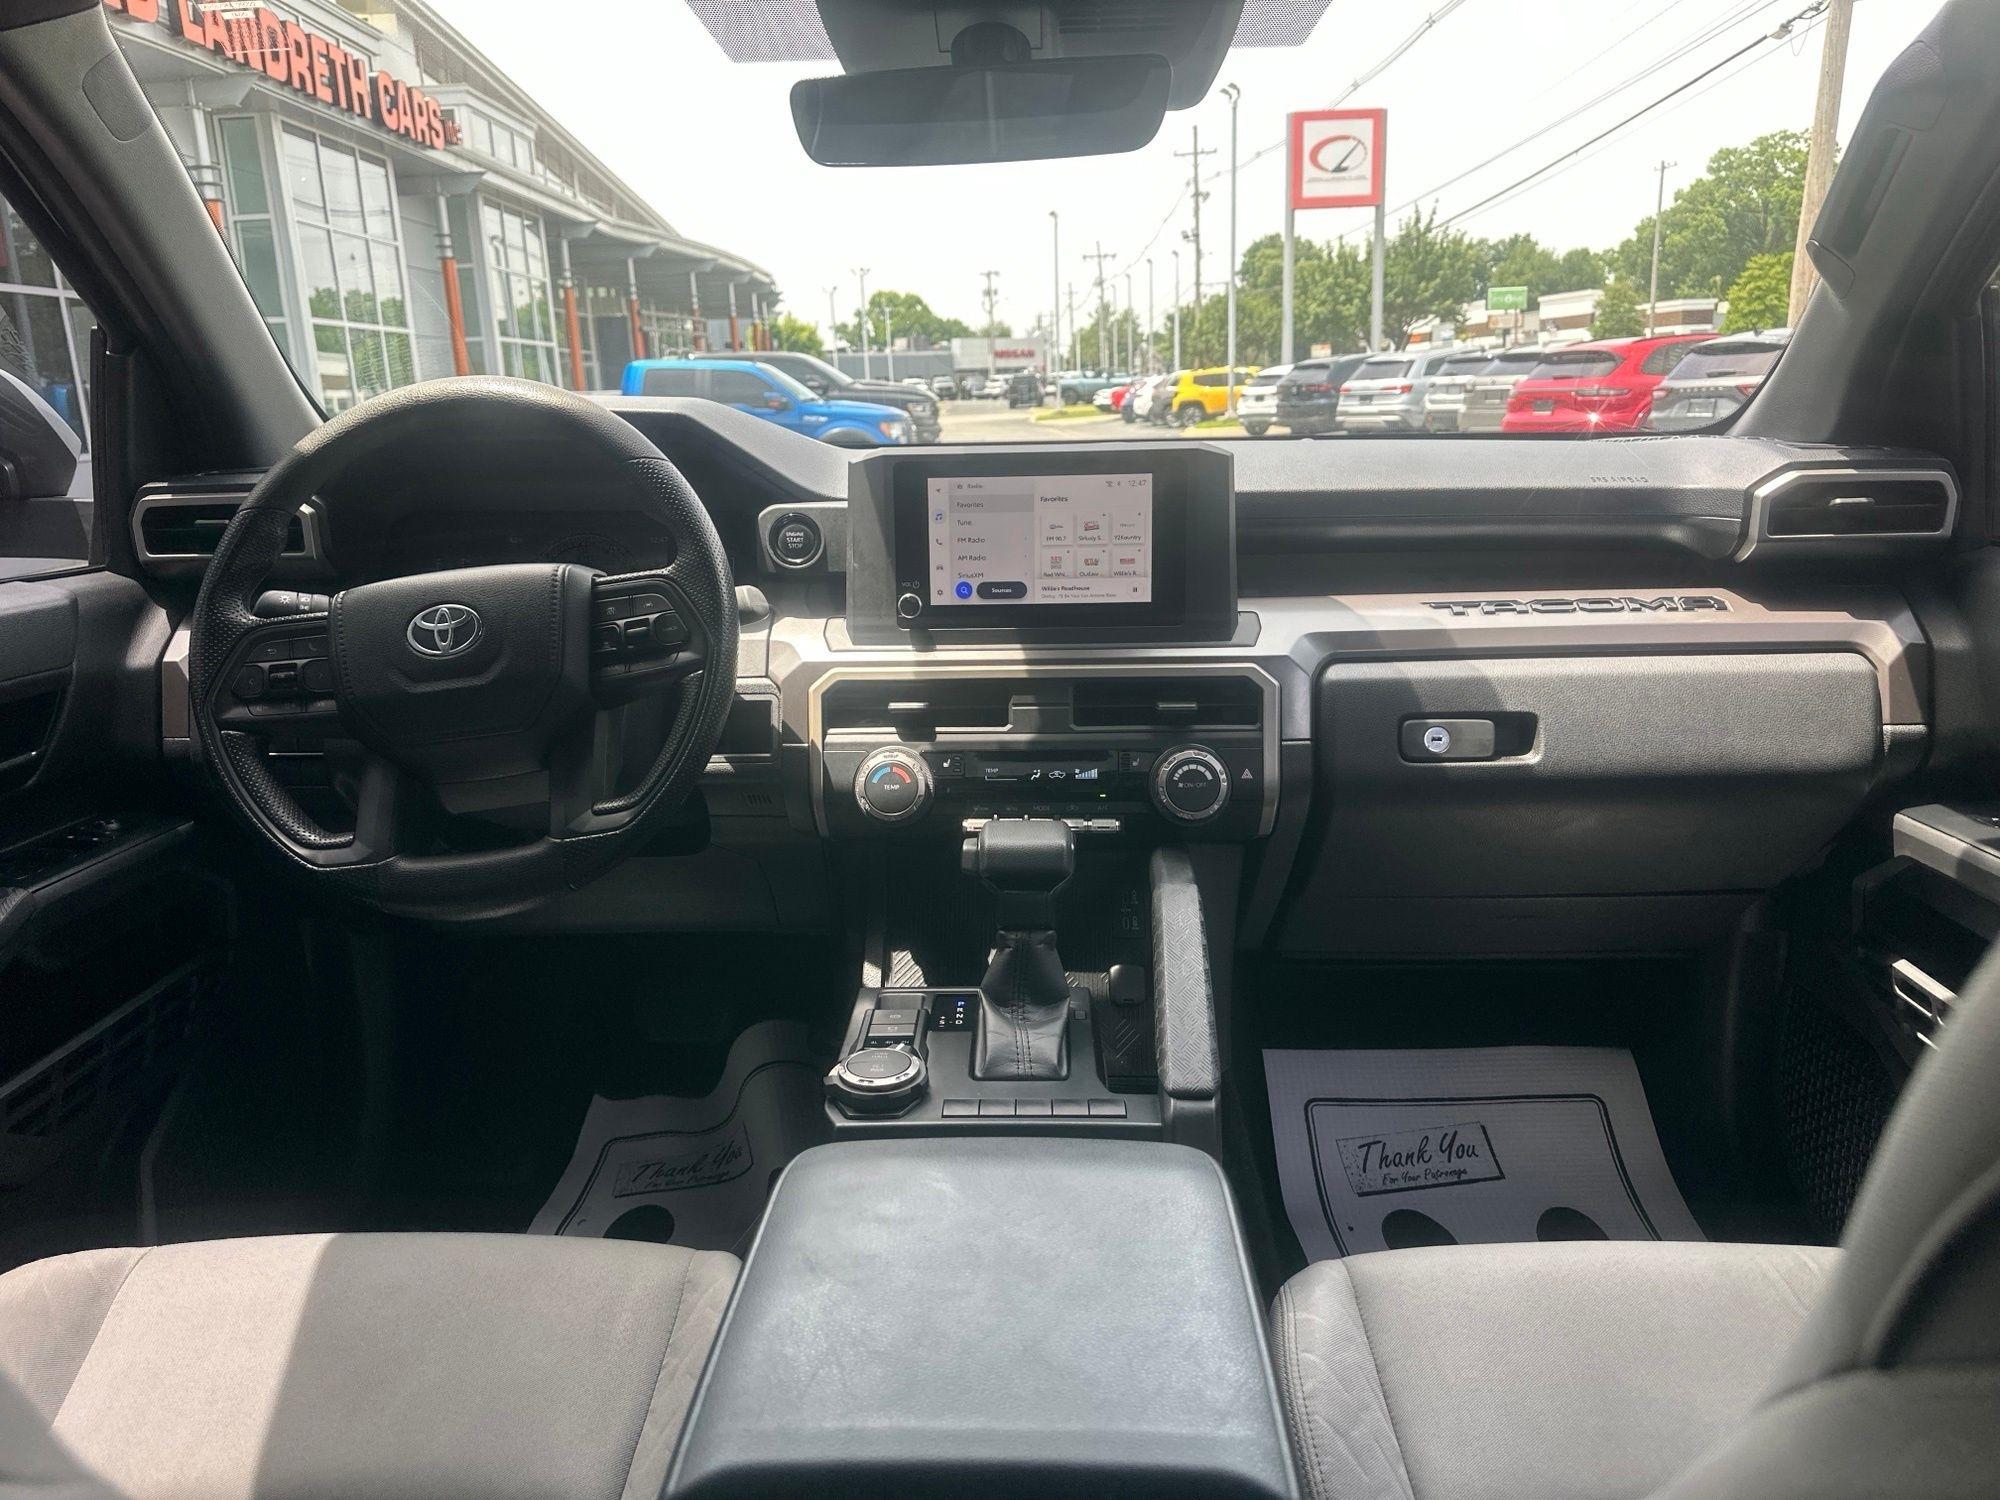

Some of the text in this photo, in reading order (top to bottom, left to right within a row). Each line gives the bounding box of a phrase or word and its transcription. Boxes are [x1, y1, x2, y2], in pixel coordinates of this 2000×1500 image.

[377, 69, 445, 151] CARS
[956, 501, 984, 509] Favorites
[1421, 596, 1732, 615] TACOMA
[883, 784, 901, 792] TEMP
[1357, 1129, 1479, 1174] Thank You
[631, 1153, 709, 1183] Thank
[1382, 1167, 1468, 1186] For Your Patronage
